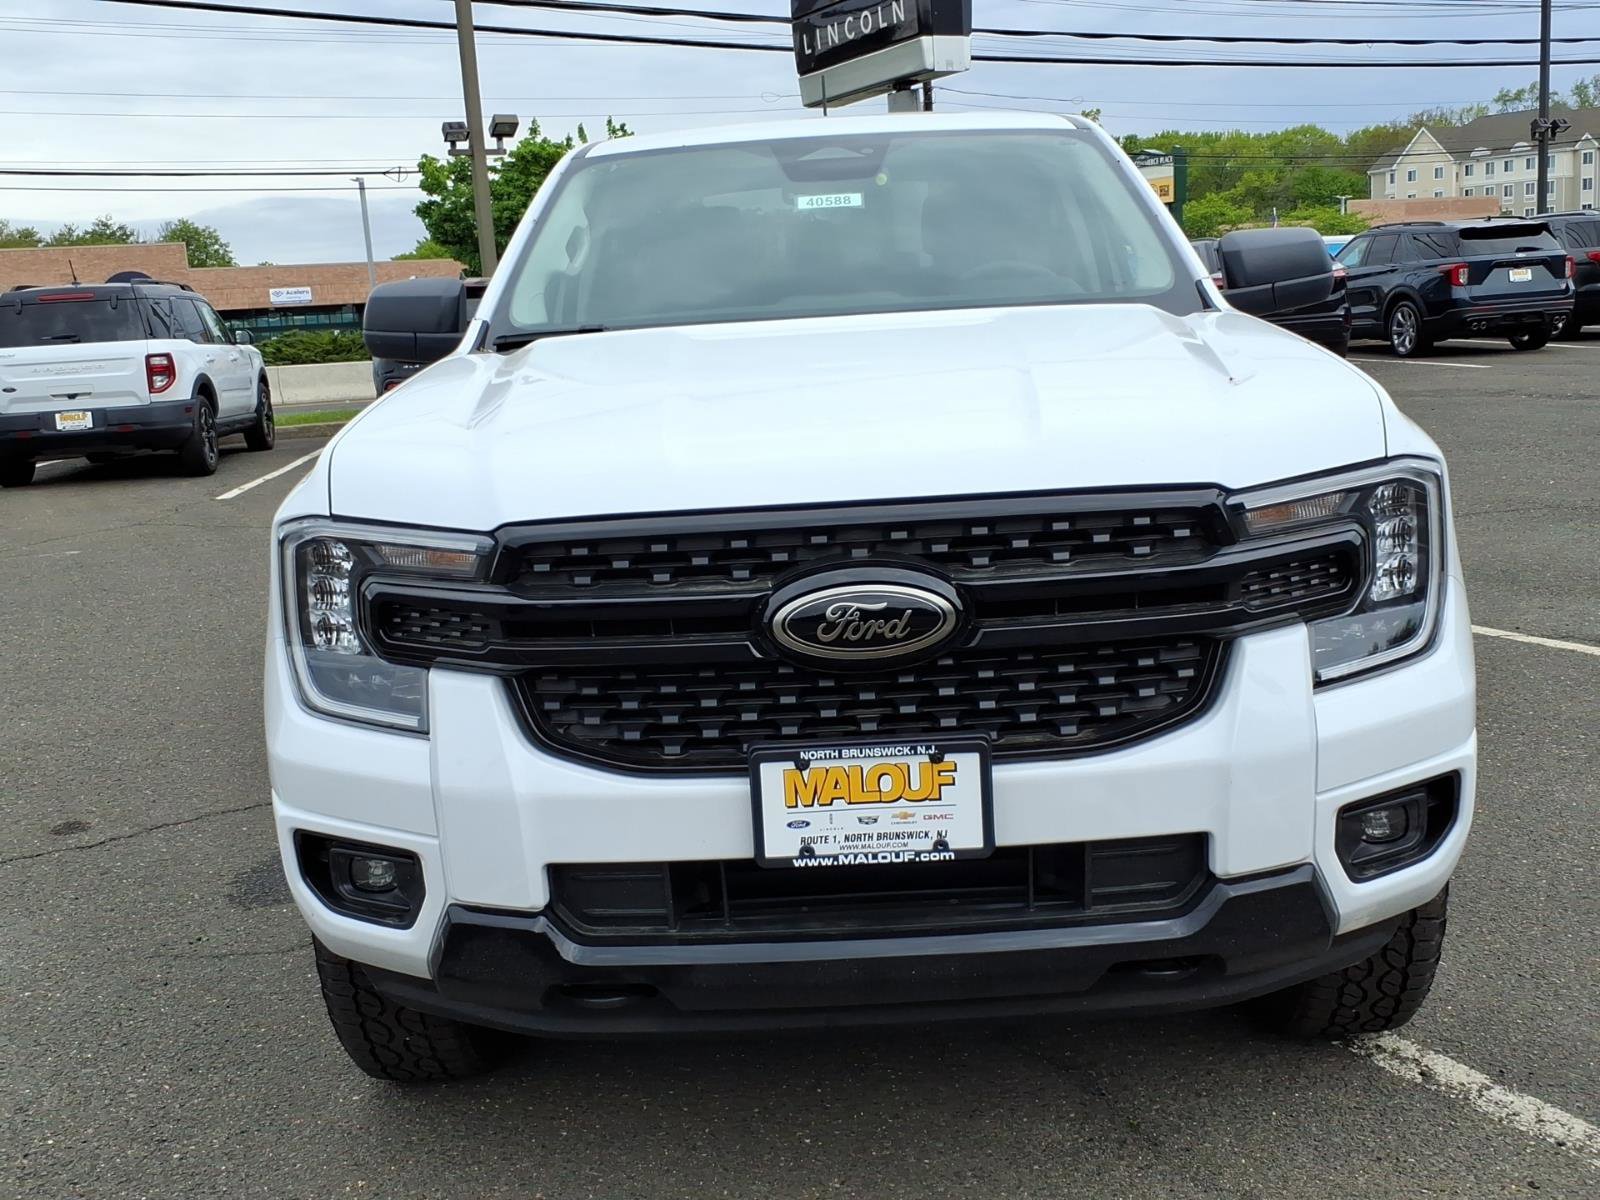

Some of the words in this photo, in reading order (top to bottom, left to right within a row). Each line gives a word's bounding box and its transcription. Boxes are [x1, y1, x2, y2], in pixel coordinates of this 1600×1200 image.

[803, 0, 905, 55] LINCOLN
[806, 196, 851, 207] 40588
[817, 602, 912, 642] Ford
[800, 750, 839, 760] NORTH
[783, 761, 957, 808] MALOUF
[800, 835, 829, 845] ROUTE
[844, 831, 873, 843] NORTH
[876, 830, 933, 841] BRUNSWICK,
[937, 830, 948, 839] NJ
[839, 841, 909, 850] WWW.MALOUF.COM
[793, 851, 955, 867] www.MALOUF.com
